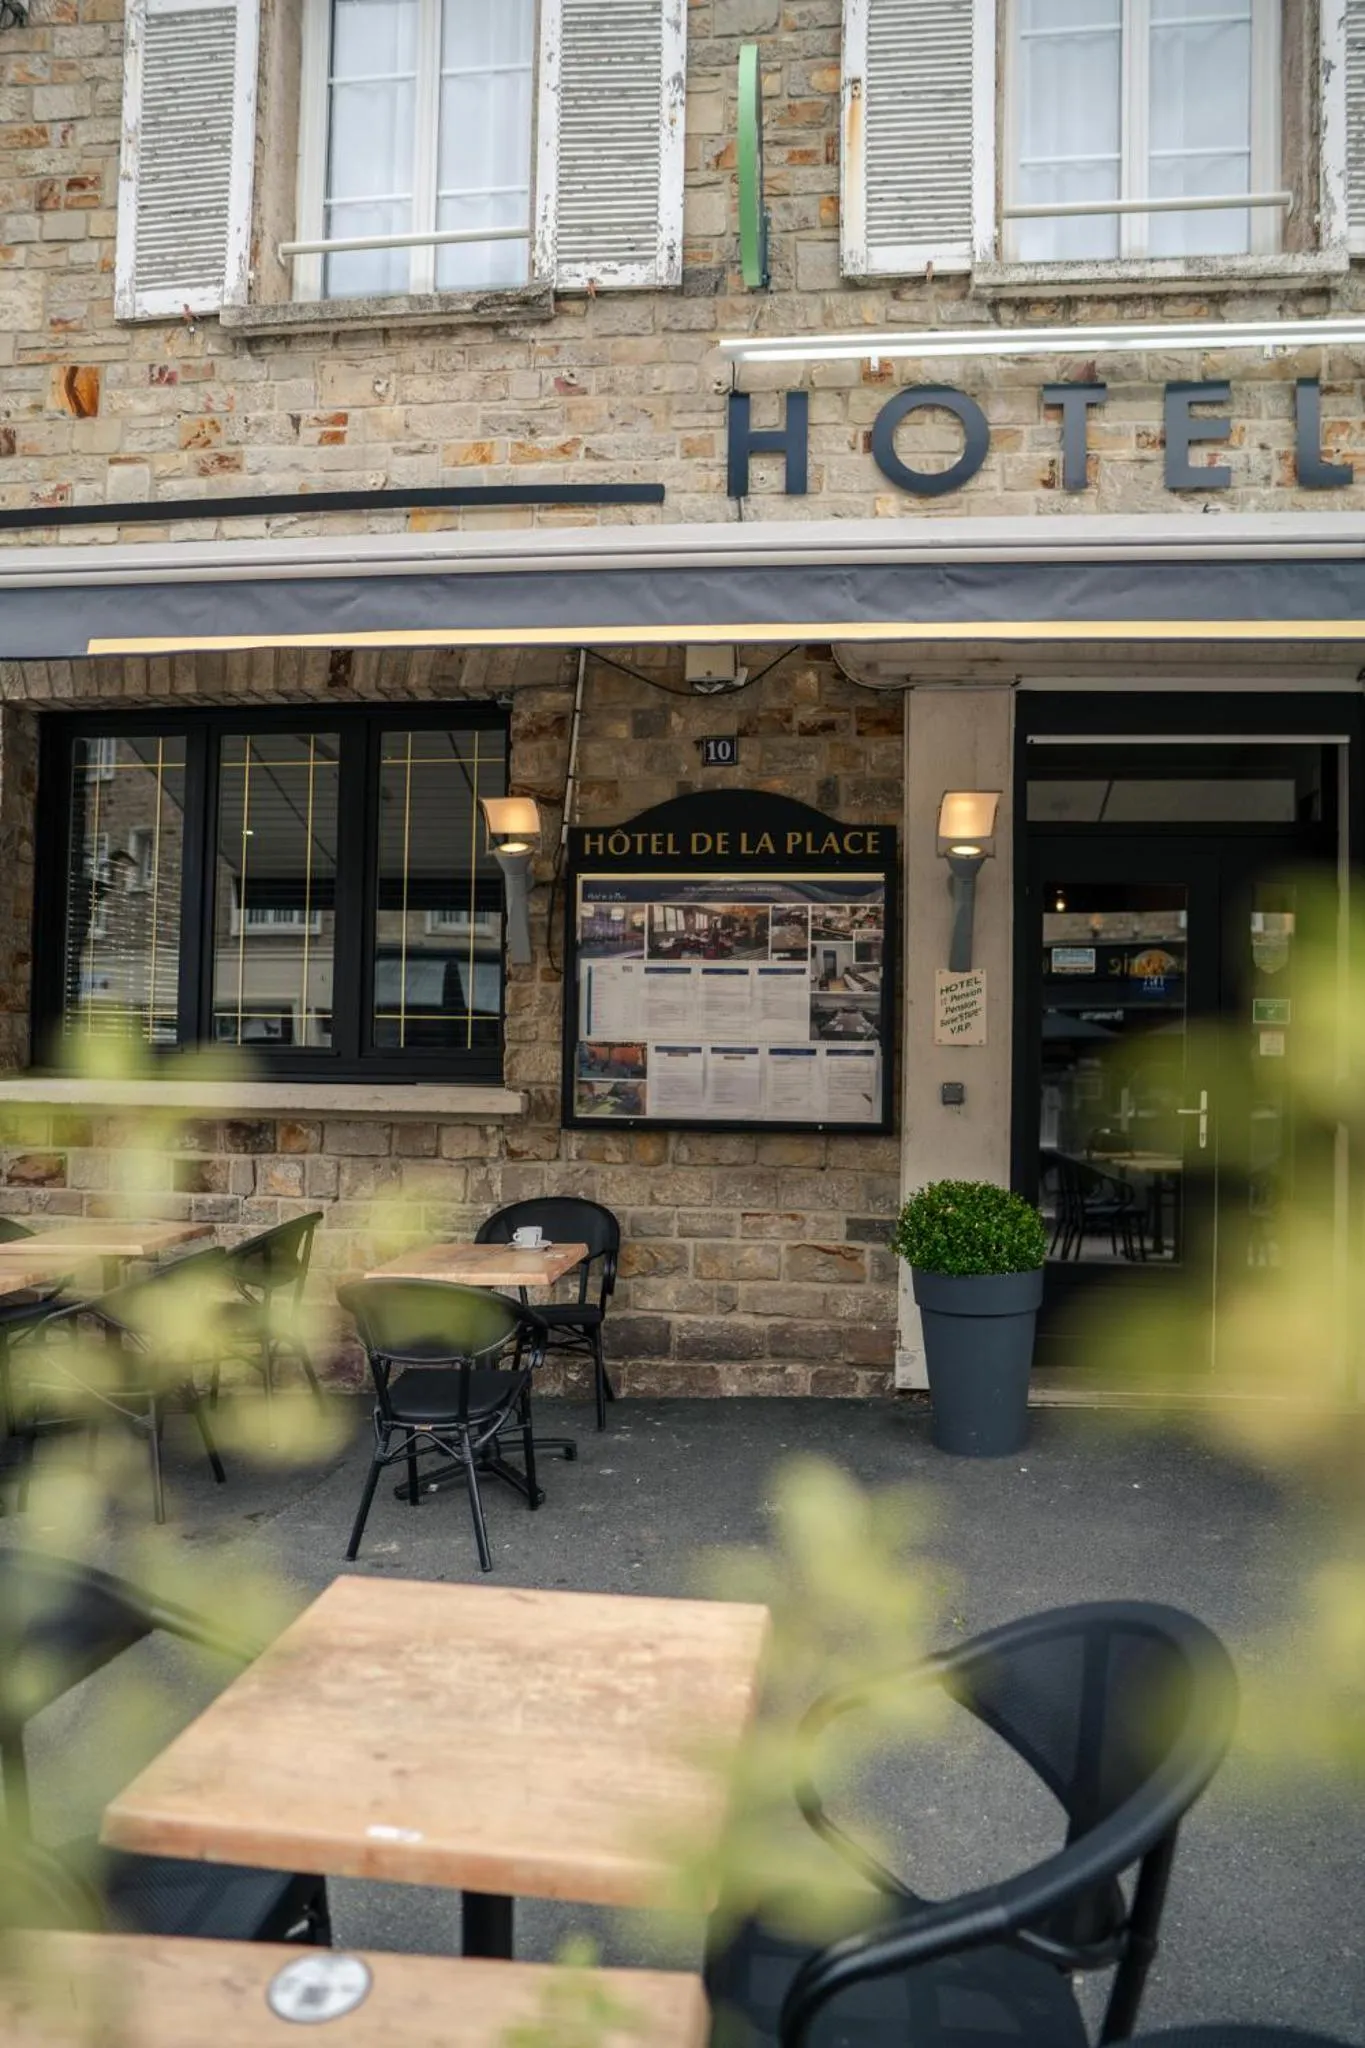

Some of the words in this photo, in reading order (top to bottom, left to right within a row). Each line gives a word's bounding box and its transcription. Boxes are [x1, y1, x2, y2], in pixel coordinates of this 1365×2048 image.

[727, 378, 1354, 497] HOTEL
[708, 741, 731, 760] 10
[584, 829, 680, 856] HÔTEL
[690, 832, 729, 855] DE
[740, 832, 776, 855] LA
[786, 831, 881, 855] PLACE
[940, 977, 982, 995] HOTEL
